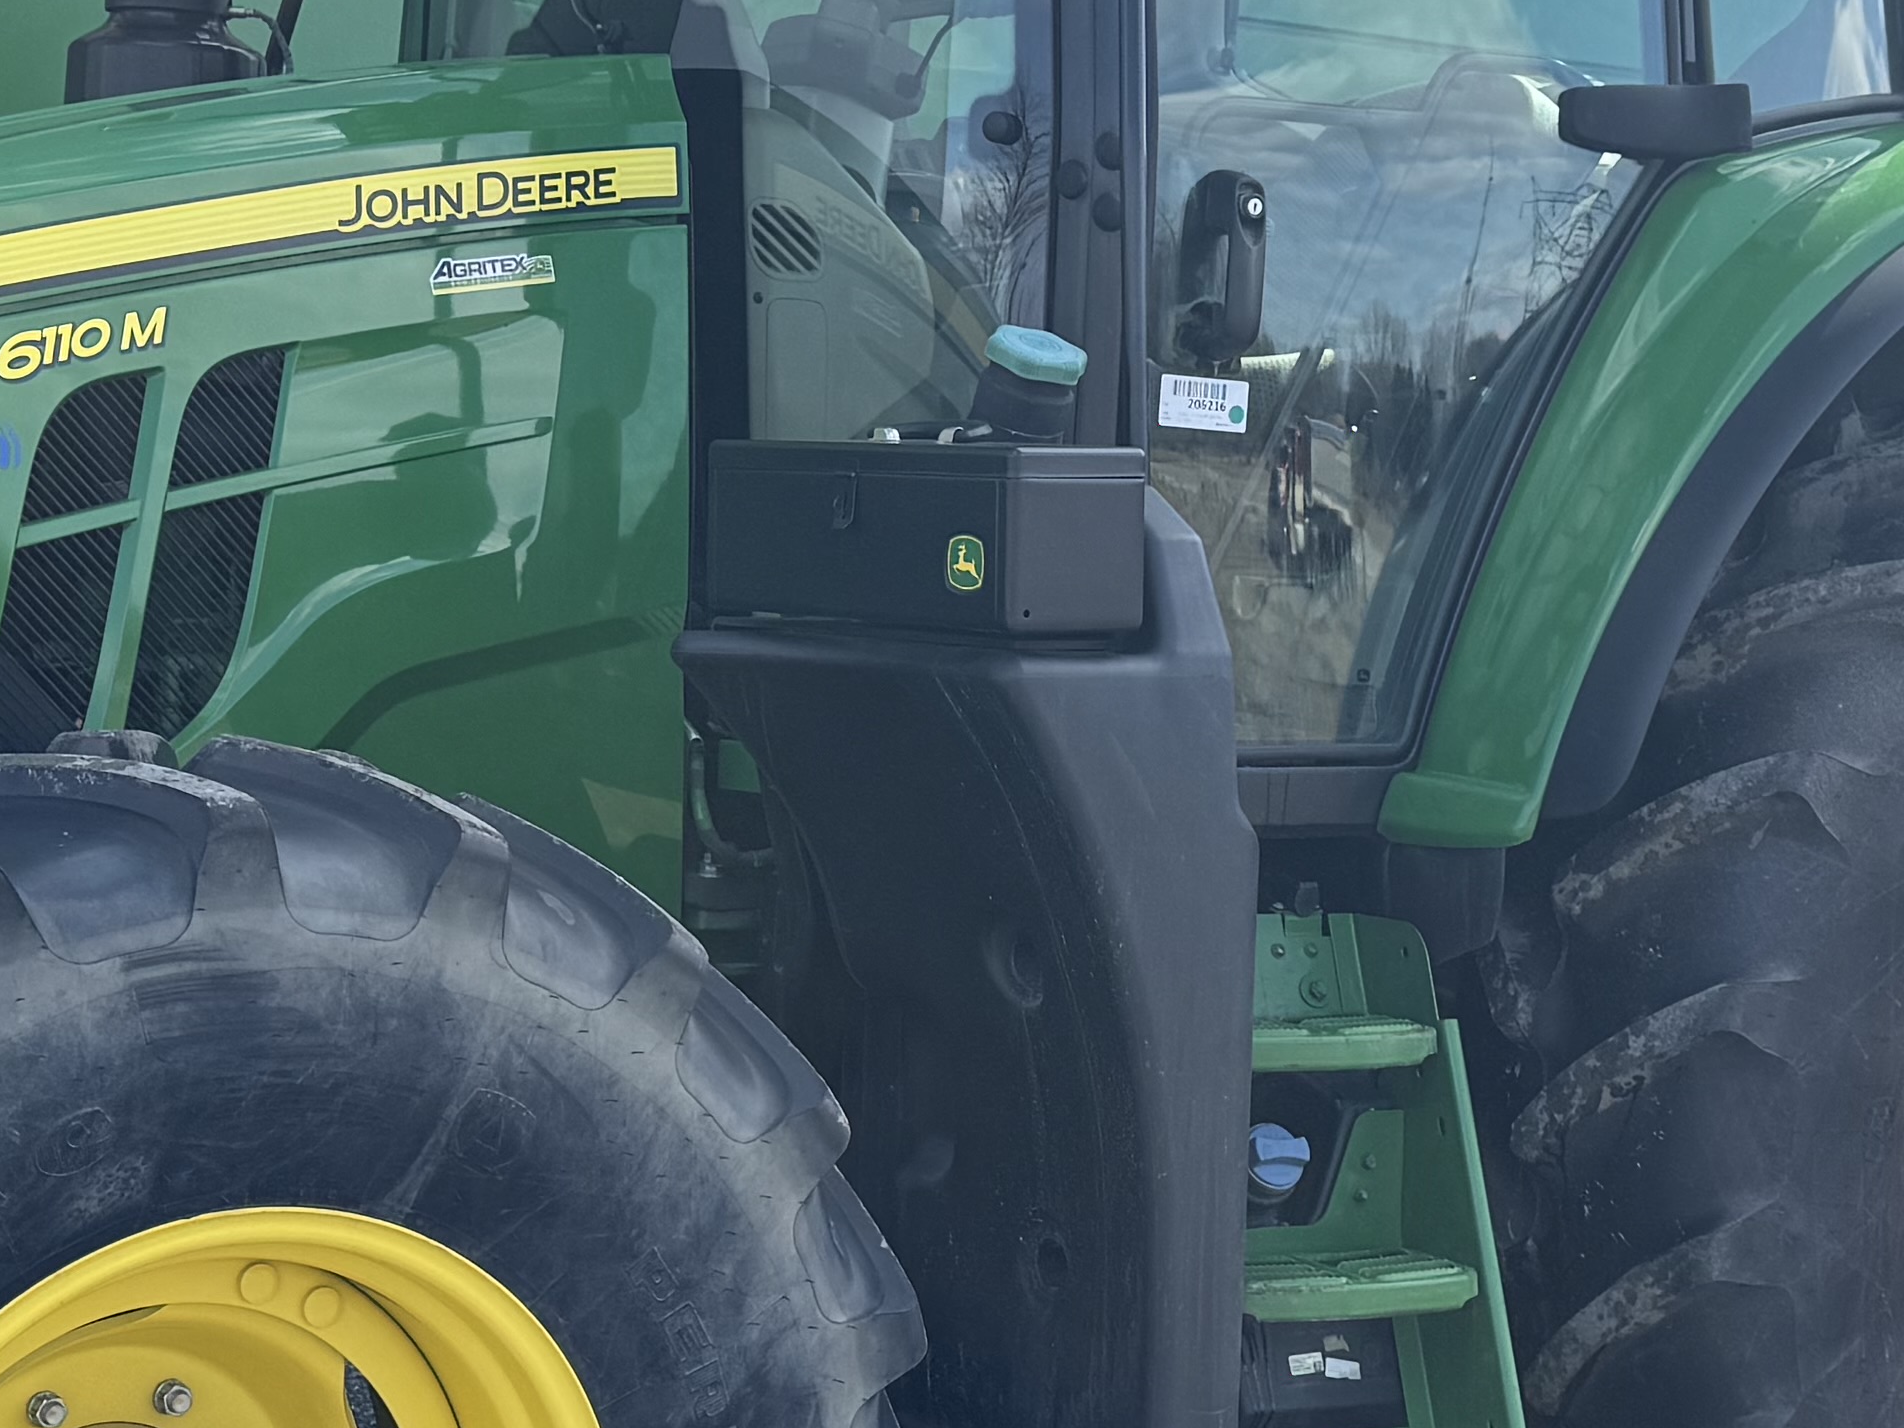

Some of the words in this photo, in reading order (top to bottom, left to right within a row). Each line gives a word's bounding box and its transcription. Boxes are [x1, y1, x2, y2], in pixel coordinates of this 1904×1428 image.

[338, 181, 464, 228] JOHN
[476, 167, 619, 212] DEERE
[433, 256, 528, 281] AGRITEX
[120, 305, 168, 352] M
